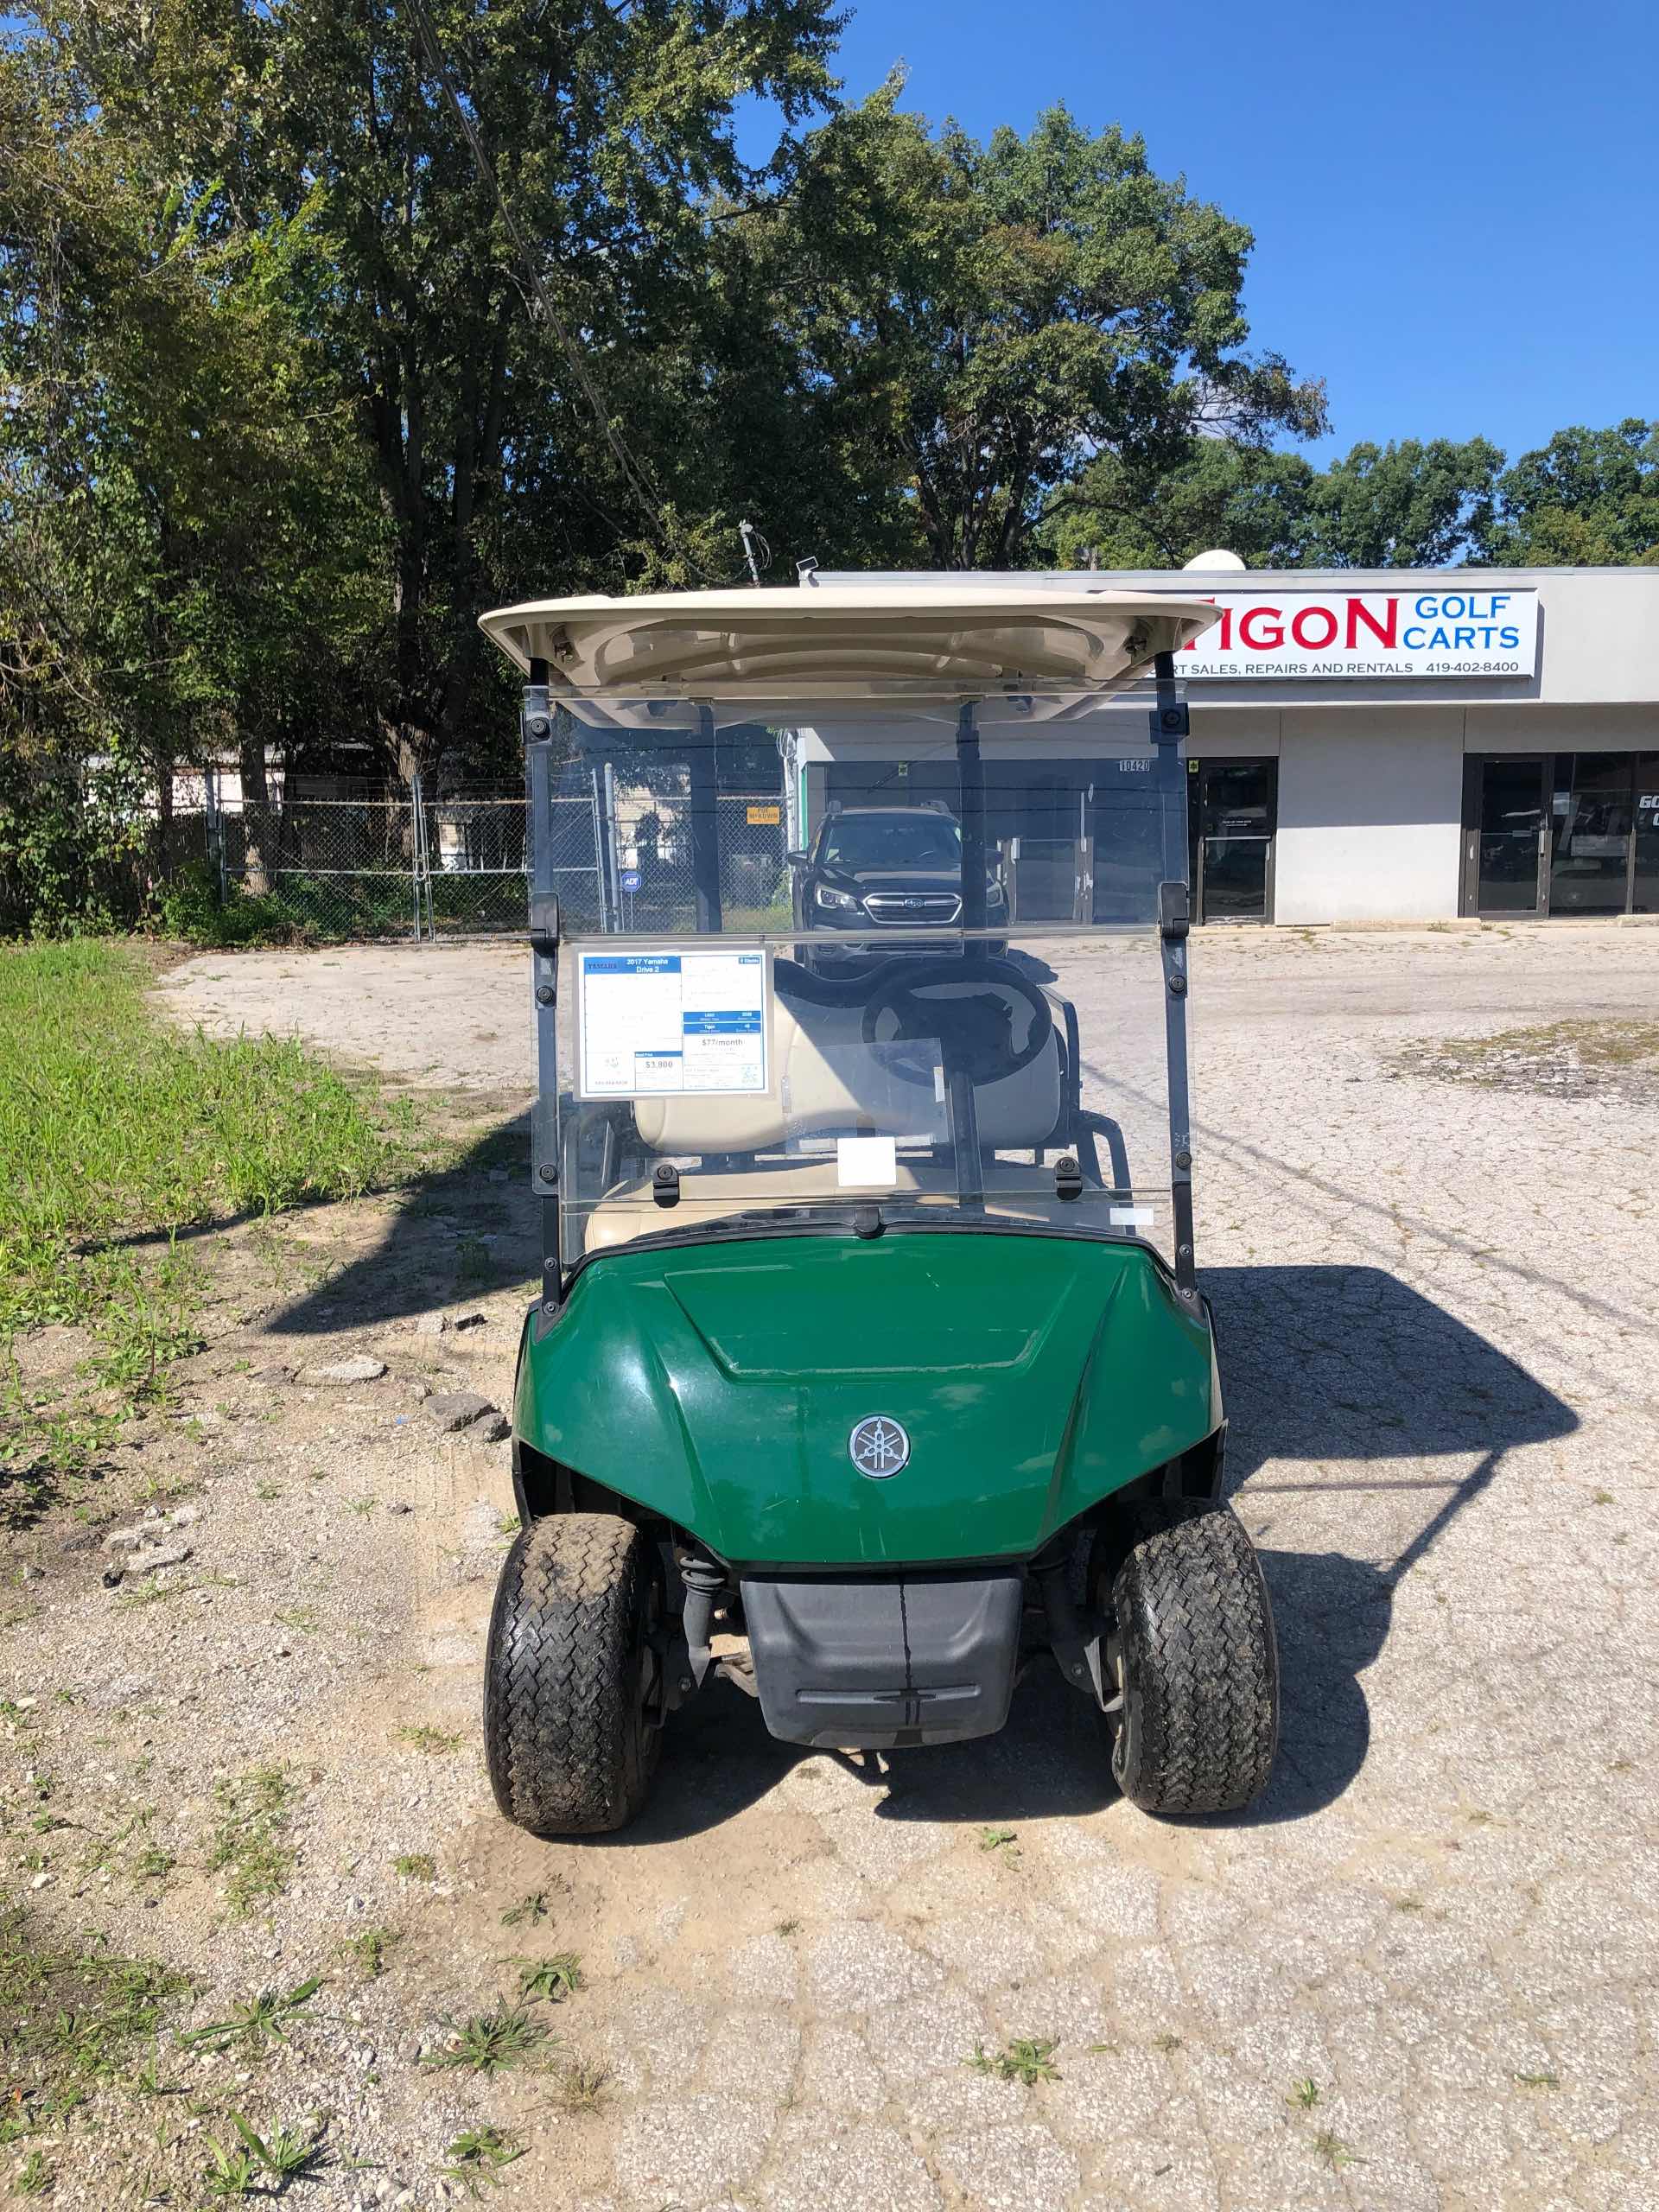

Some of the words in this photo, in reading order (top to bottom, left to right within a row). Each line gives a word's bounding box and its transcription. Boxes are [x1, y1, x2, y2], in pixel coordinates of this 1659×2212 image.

[1415, 596, 1511, 620] GOLF
[1181, 597, 1401, 651] IGON
[1403, 626, 1520, 650] CARTS
[1191, 664, 1242, 676] SALES,
[1245, 664, 1307, 675] REPAIRS
[1312, 663, 1344, 673] AND
[1347, 663, 1414, 673] RENTALS
[1426, 662, 1519, 673] 419-402-8400
[1122, 760, 1149, 771] 10420
